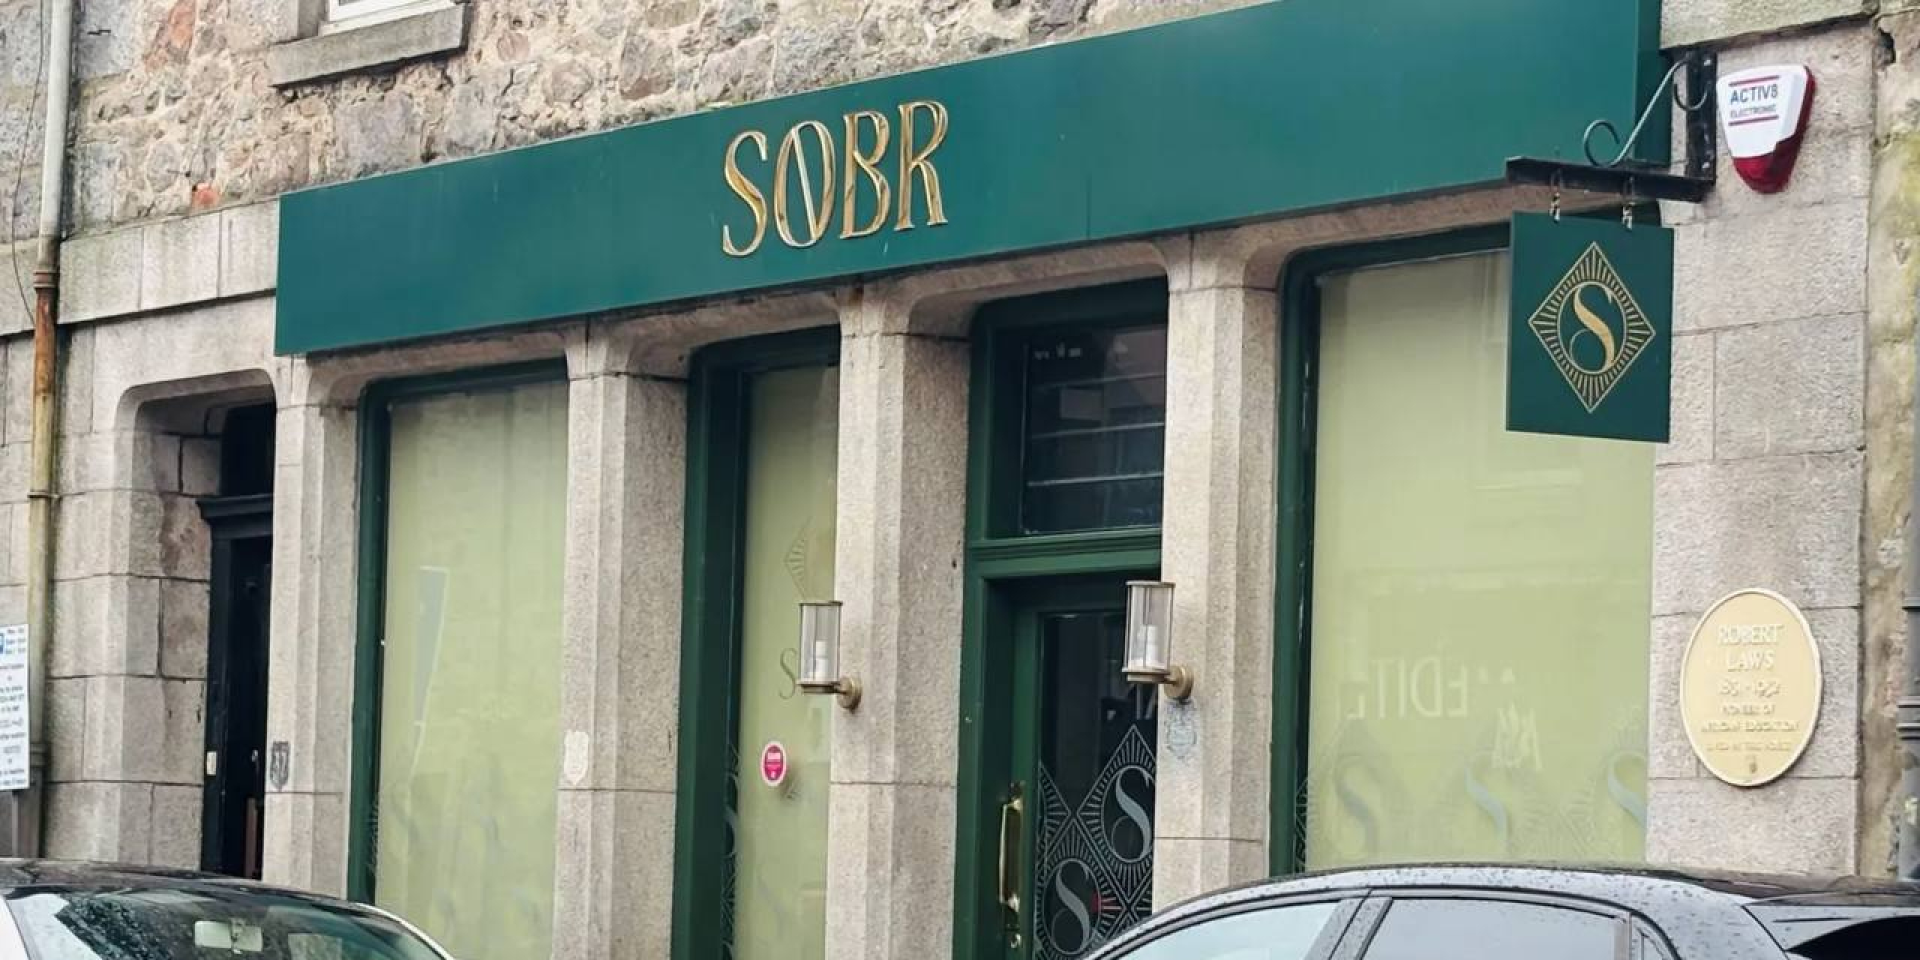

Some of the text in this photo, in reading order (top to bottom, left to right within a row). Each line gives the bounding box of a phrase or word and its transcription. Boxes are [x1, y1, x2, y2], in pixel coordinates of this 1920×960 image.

[1730, 84, 1778, 105] ACTIV8
[722, 101, 949, 256] SOBR
[1726, 649, 1775, 673] LAWS
